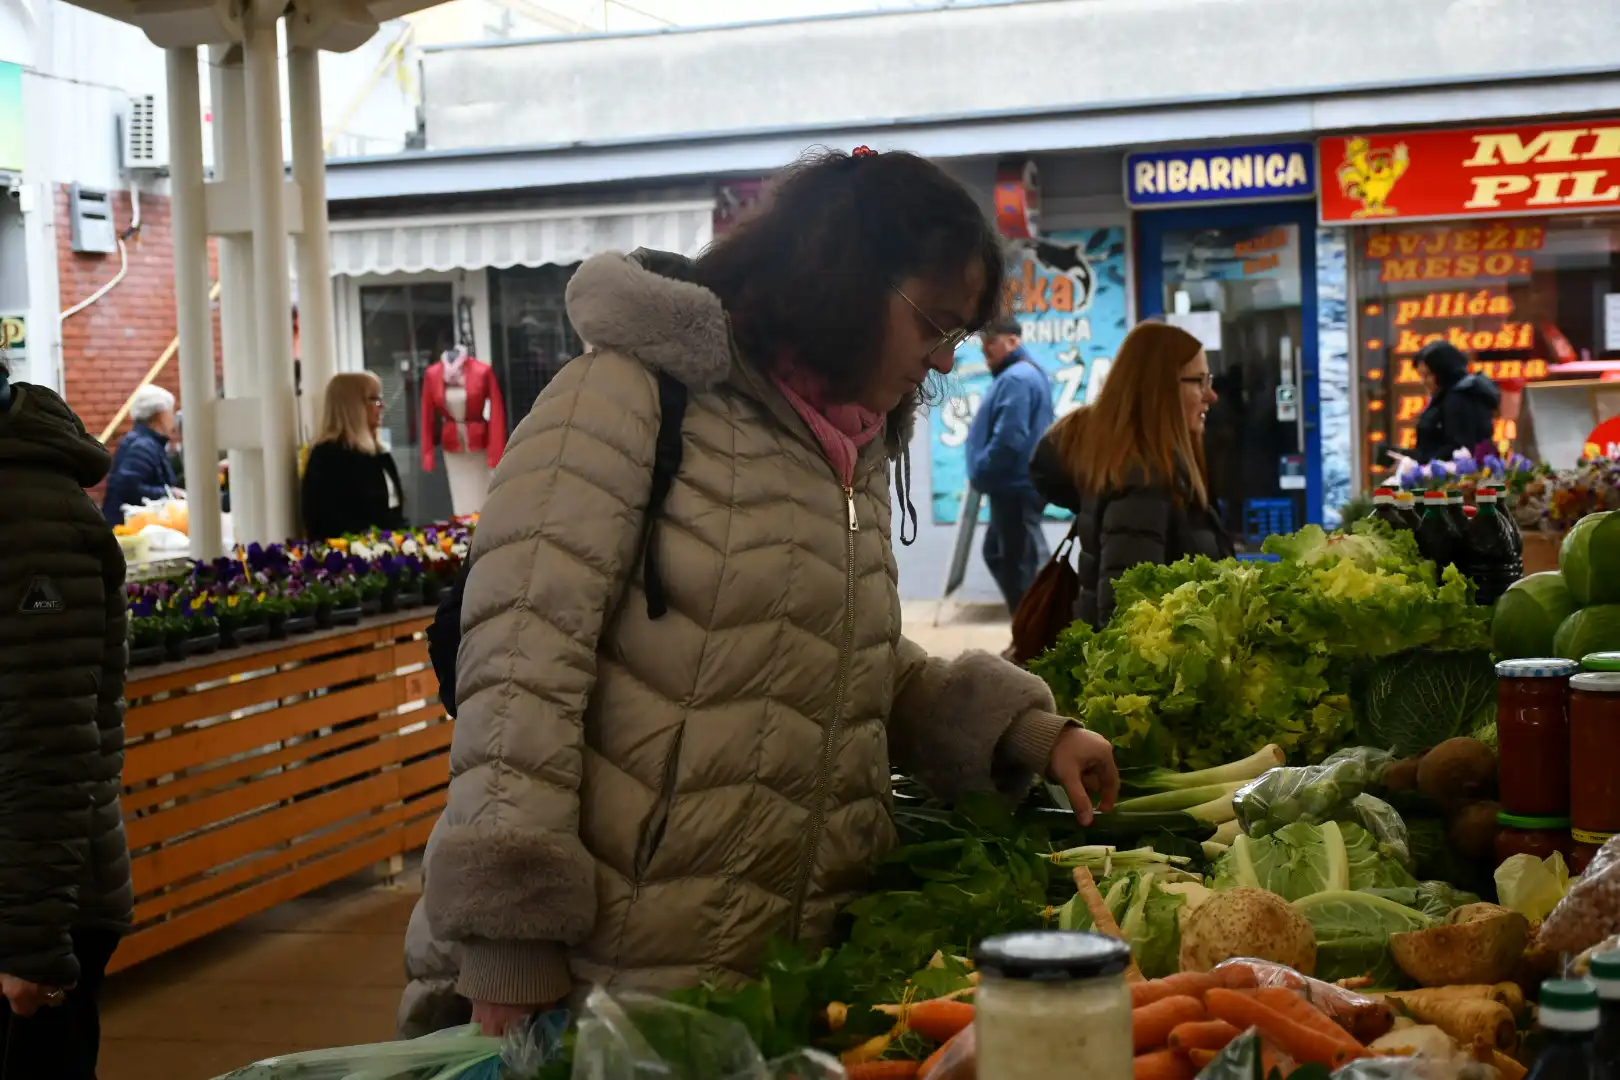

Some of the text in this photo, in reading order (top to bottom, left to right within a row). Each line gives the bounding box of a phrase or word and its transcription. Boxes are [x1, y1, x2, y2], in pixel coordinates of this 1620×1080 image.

[1133, 151, 1308, 196] RIBARNICA
[1366, 222, 1546, 258] SVJEŽE
[1380, 252, 1533, 283] MESO:
[1394, 289, 1513, 325] pilića
